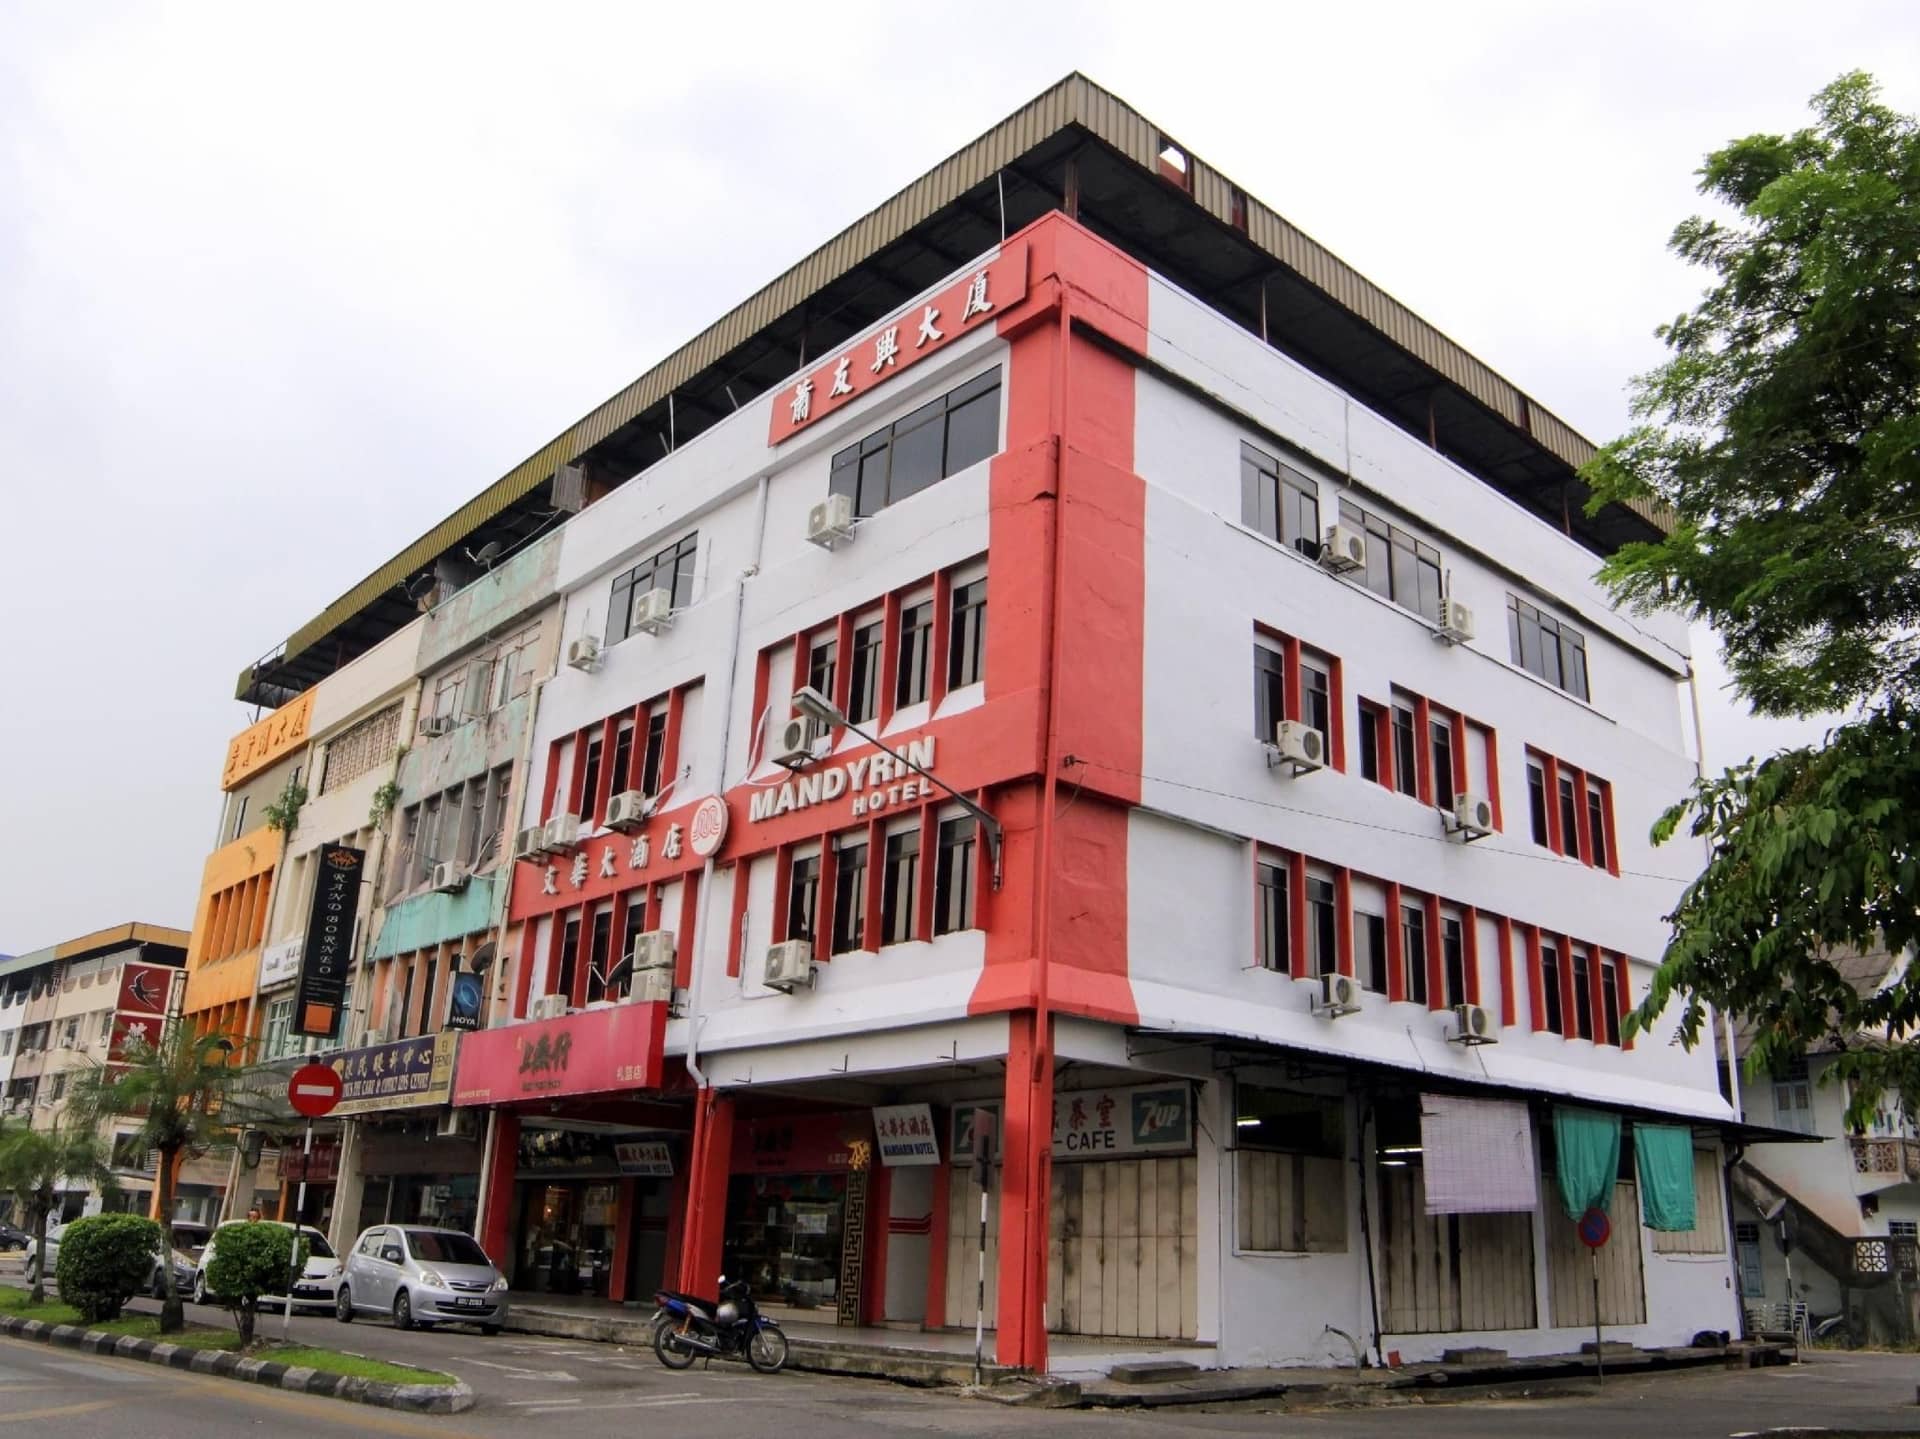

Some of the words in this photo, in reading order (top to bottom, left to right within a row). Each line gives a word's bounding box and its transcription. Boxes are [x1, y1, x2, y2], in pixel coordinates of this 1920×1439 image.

[749, 736, 935, 823] MANDYRIN
[852, 777, 934, 816] HOTEL
[542, 822, 682, 895] 文華大酒店
[452, 1015, 476, 1026] HOYA
[1138, 1098, 1181, 1138] 7UP
